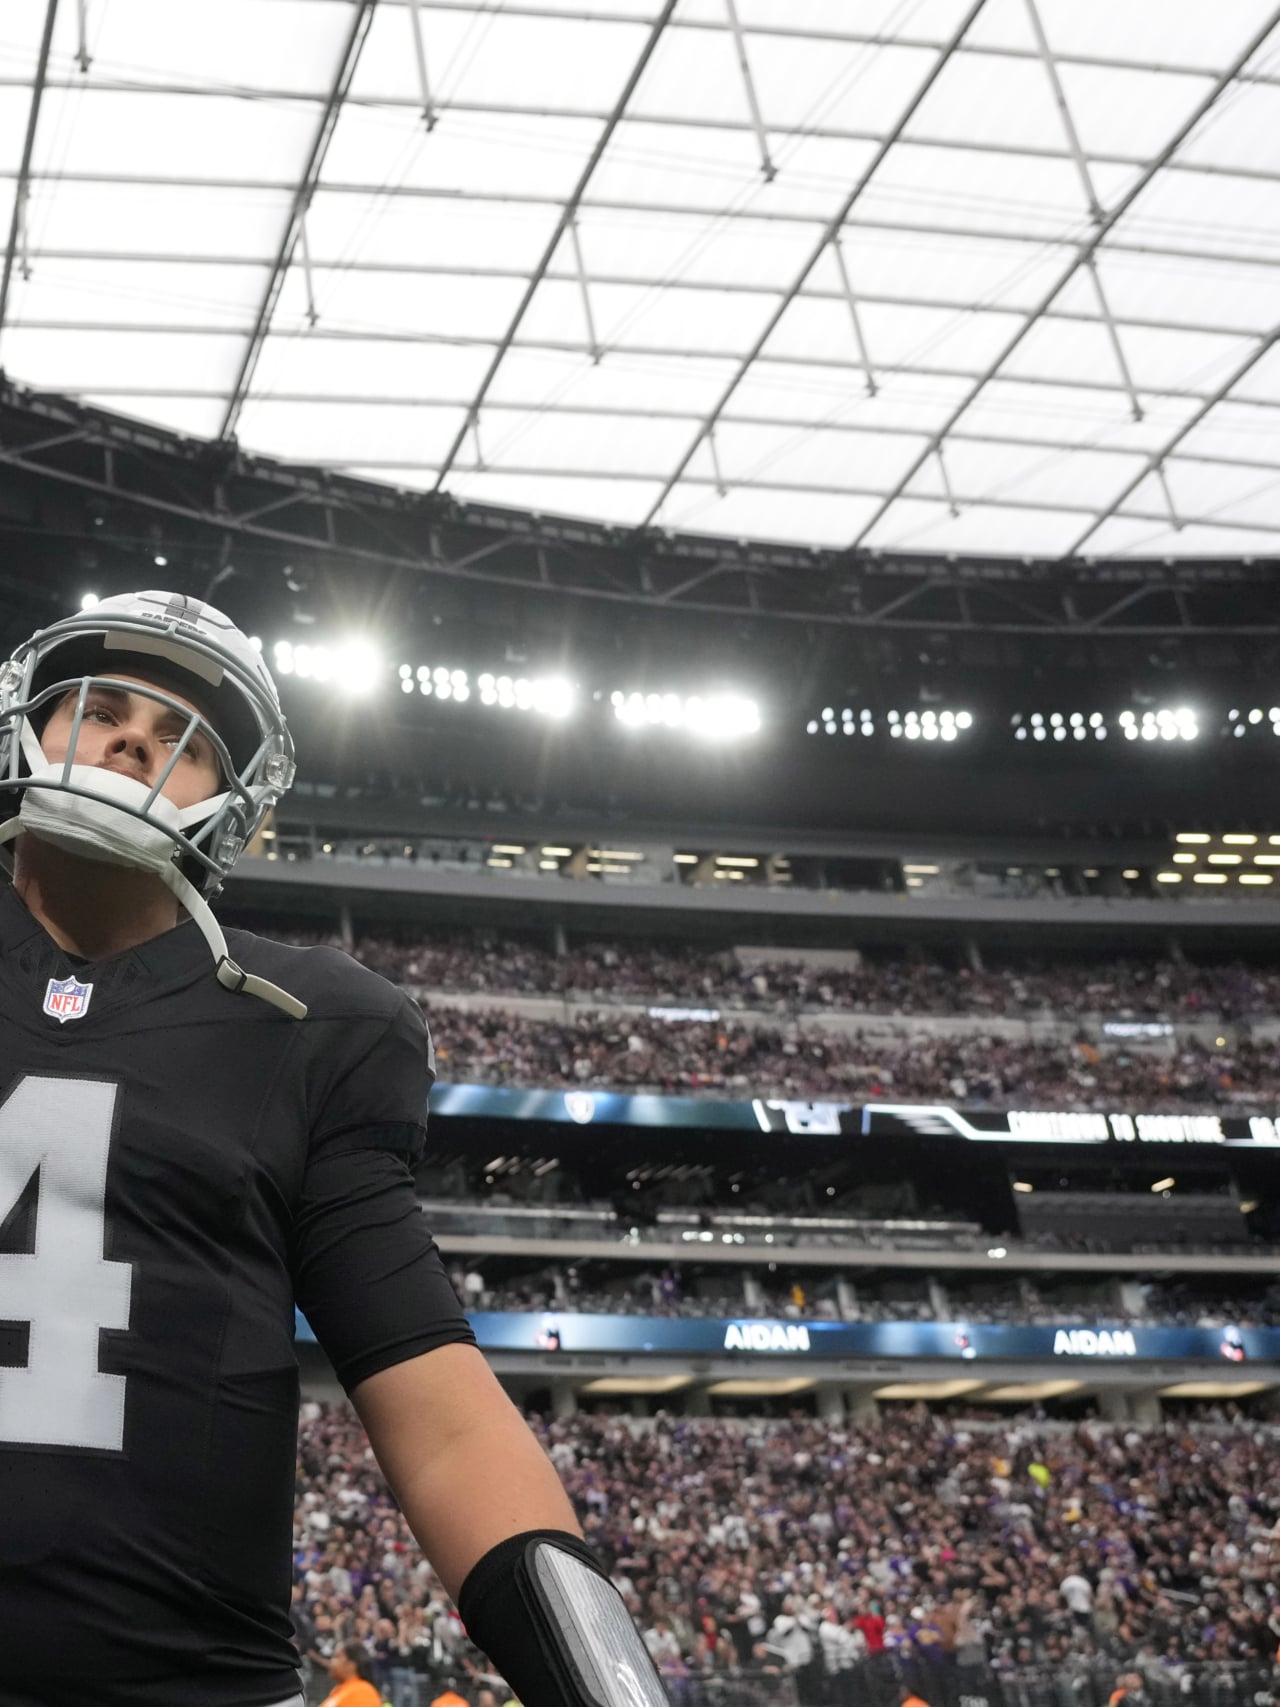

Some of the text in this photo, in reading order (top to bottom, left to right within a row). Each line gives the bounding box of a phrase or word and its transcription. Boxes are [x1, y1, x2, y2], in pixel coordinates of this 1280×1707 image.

[50, 993, 81, 1013] NFL
[724, 1324, 811, 1350] AIDAN
[1053, 1330, 1137, 1356] AIDAN
